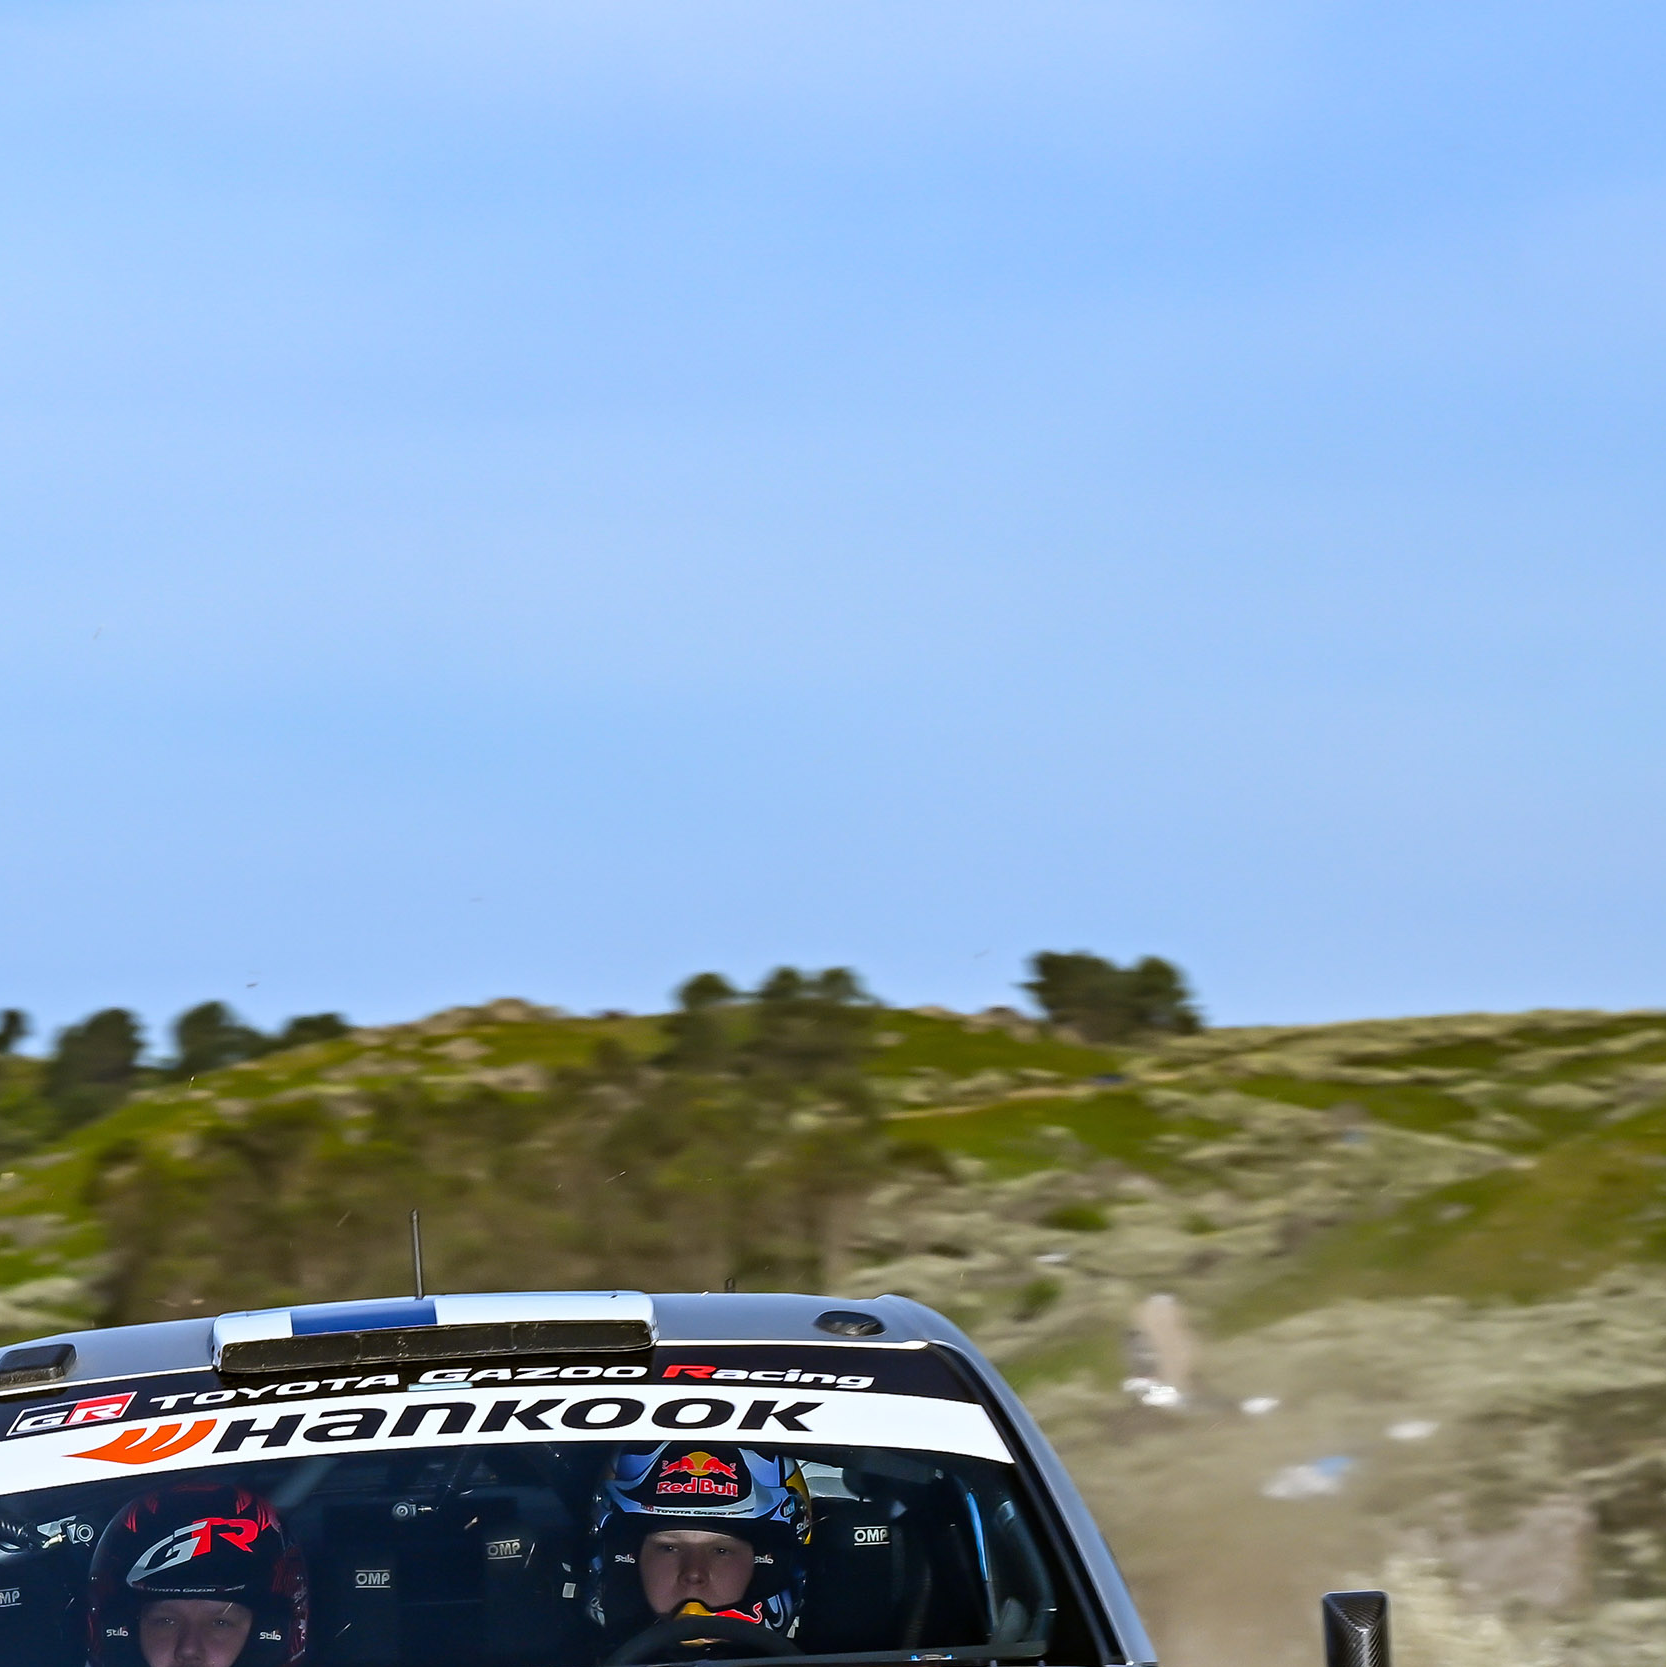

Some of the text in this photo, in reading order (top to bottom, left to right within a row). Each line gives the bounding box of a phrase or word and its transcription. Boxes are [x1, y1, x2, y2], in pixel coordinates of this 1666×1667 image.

[149, 1365, 874, 1409] TOYOTA GAZOO Racing
[16, 1402, 123, 1432] GR
[656, 1477, 738, 1498] Red Bull
[854, 1529, 888, 1542] OMP
[126, 1517, 259, 1587] GR
[488, 1541, 521, 1556] OMP
[356, 1572, 391, 1585] OMP
